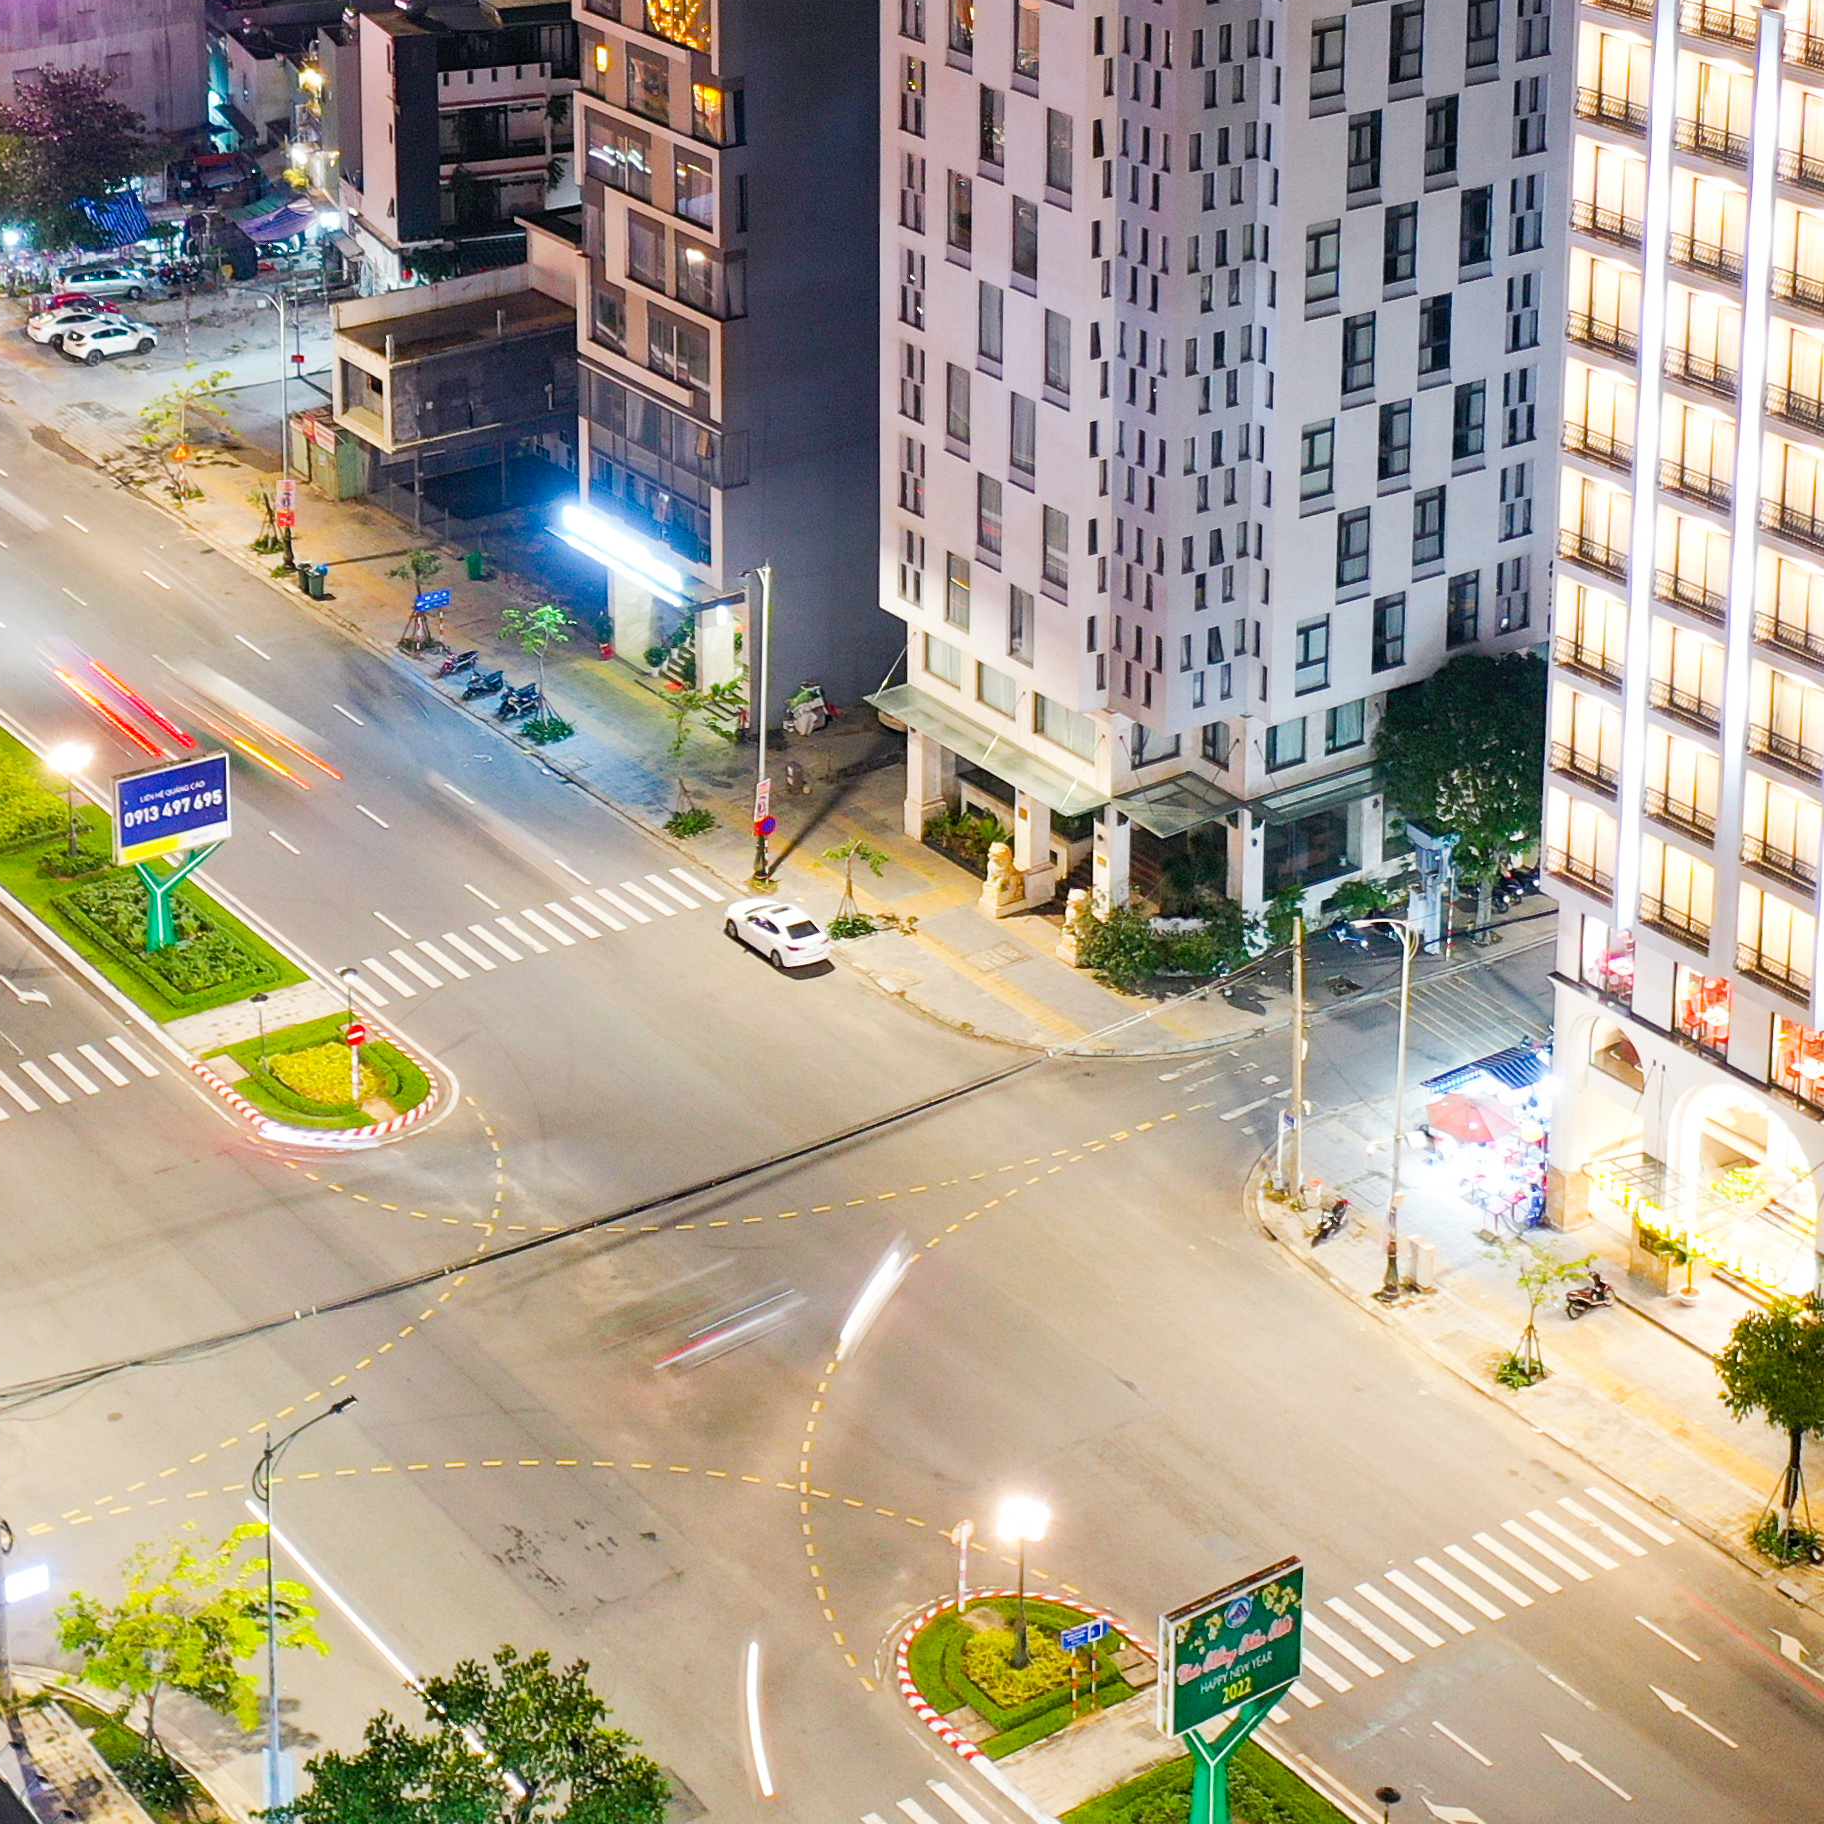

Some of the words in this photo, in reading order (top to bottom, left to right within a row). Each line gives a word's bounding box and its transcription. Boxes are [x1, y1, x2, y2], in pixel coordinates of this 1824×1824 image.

[124, 805, 160, 829] 0913
[161, 796, 191, 818] 497
[193, 788, 224, 810] 695
[1199, 1668, 1229, 1695] HAPPY
[1229, 1661, 1251, 1681] NEW
[1251, 1650, 1274, 1669] YEAR
[1221, 1676, 1254, 1705] 2022
